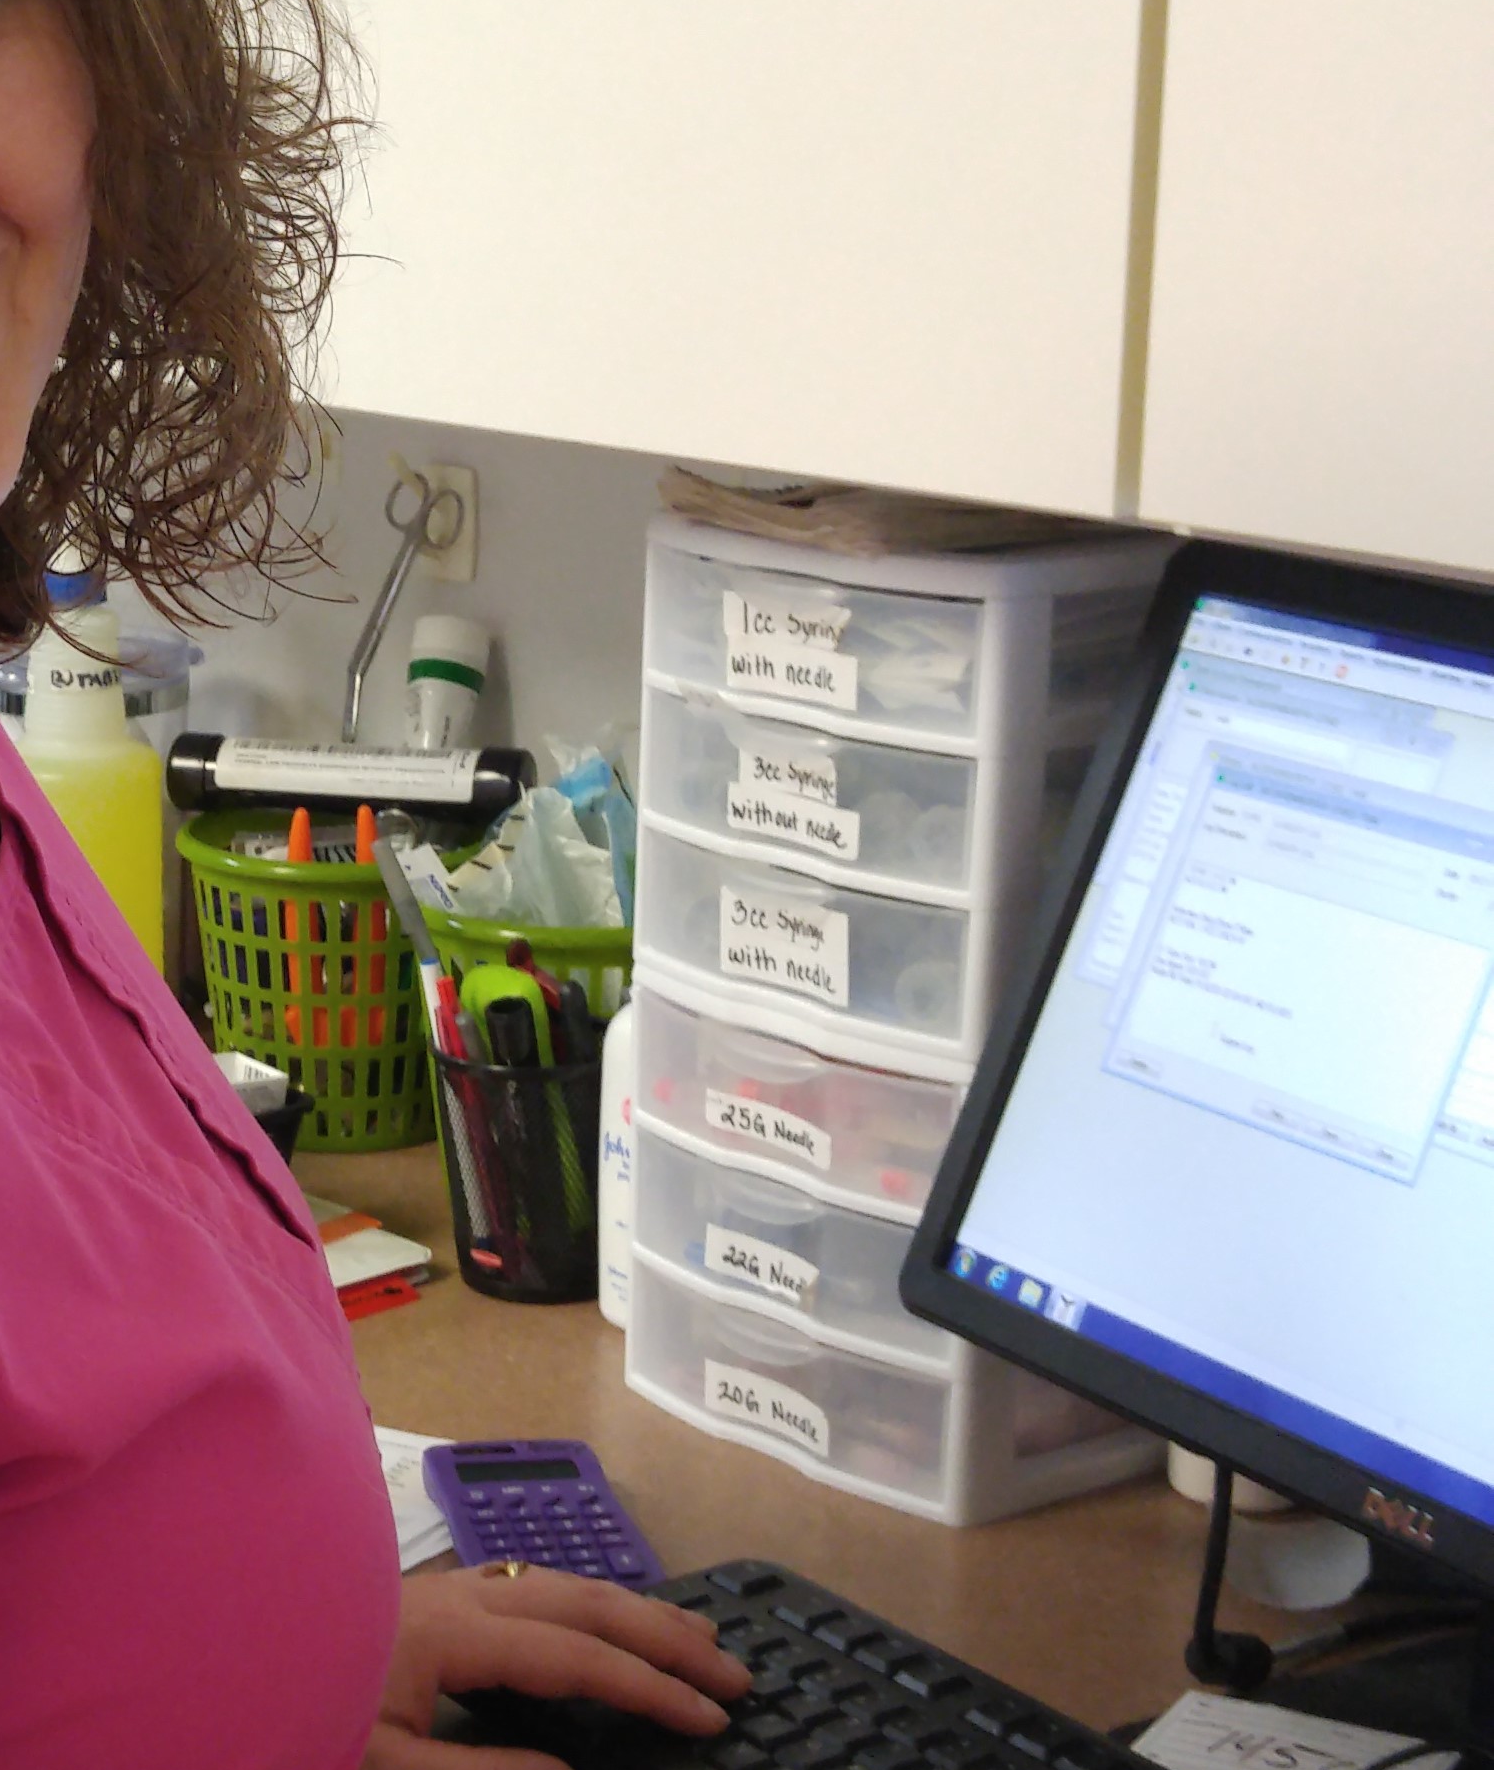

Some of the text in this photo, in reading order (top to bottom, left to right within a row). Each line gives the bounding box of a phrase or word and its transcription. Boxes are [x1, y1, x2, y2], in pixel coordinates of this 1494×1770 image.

[731, 653, 835, 692] with needle
[728, 945, 777, 972] with
[717, 1381, 761, 1414] 20G
